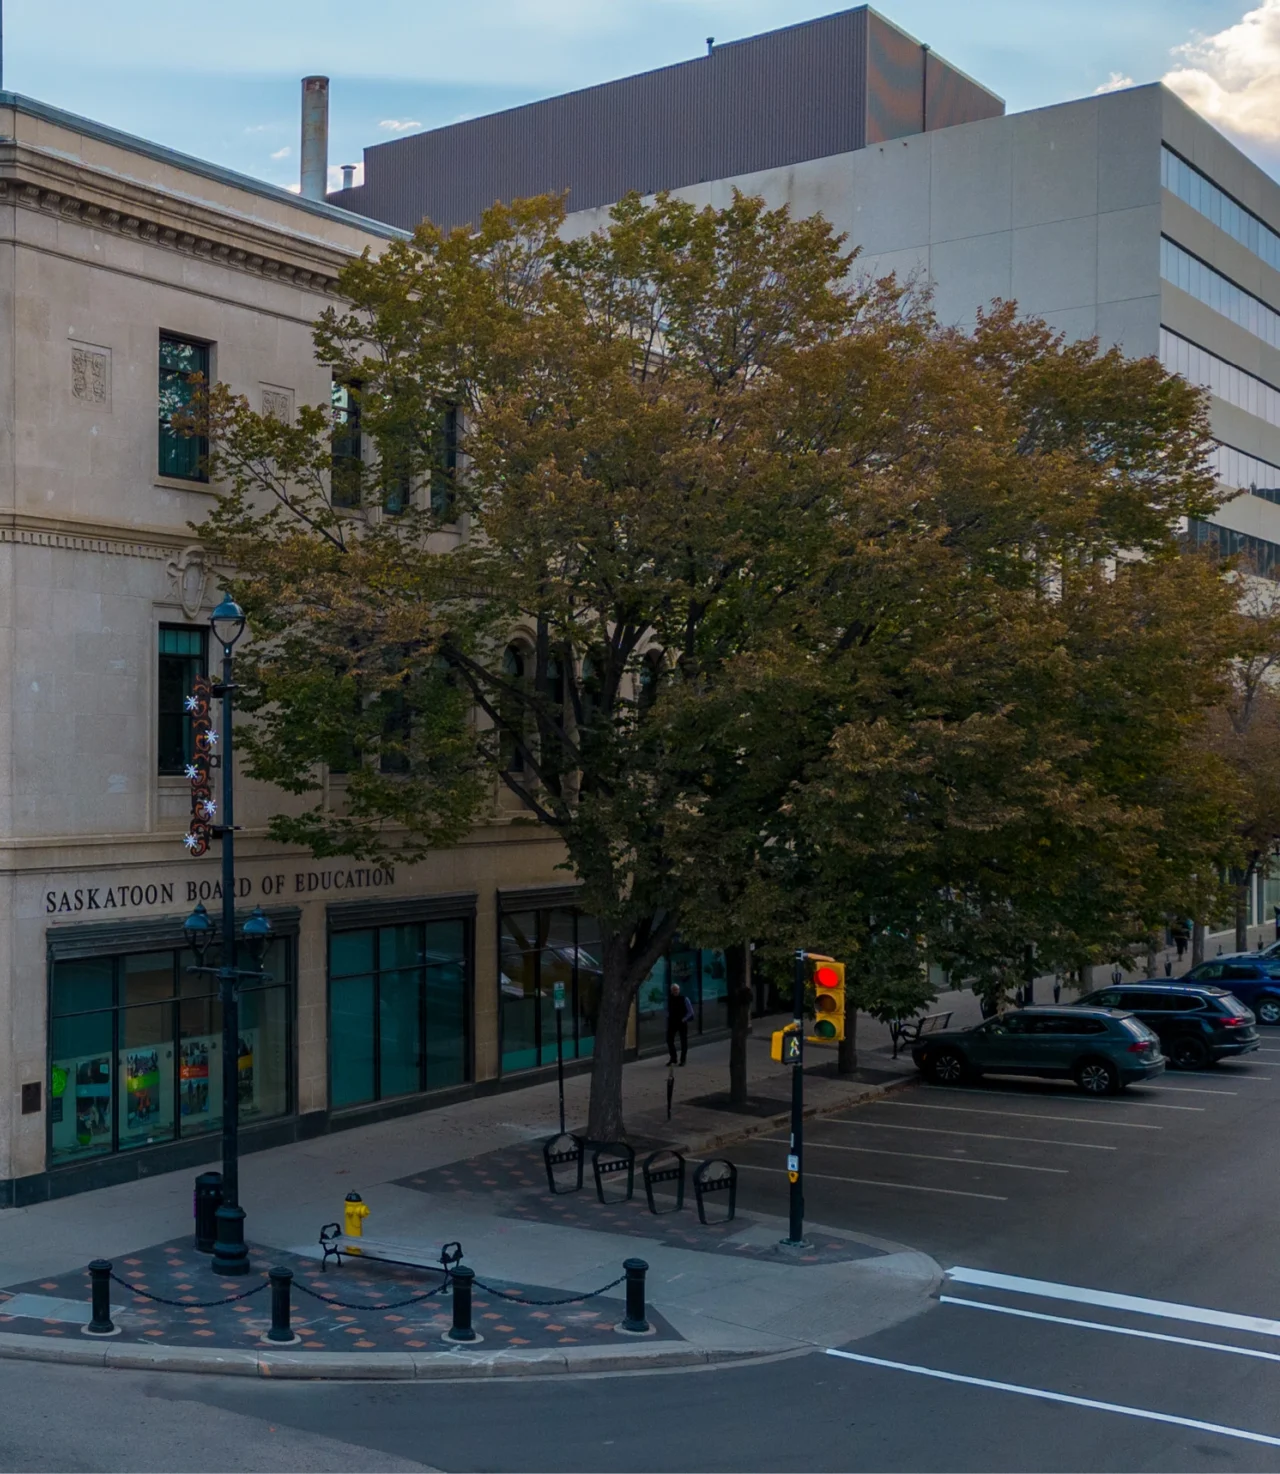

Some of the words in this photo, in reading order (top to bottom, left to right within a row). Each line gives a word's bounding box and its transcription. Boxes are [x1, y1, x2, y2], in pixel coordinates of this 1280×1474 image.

[46, 882, 174, 913] SASKATOON
[187, 876, 251, 901] BOAD
[261, 874, 285, 895] OF
[295, 867, 396, 893] EDUCATION
